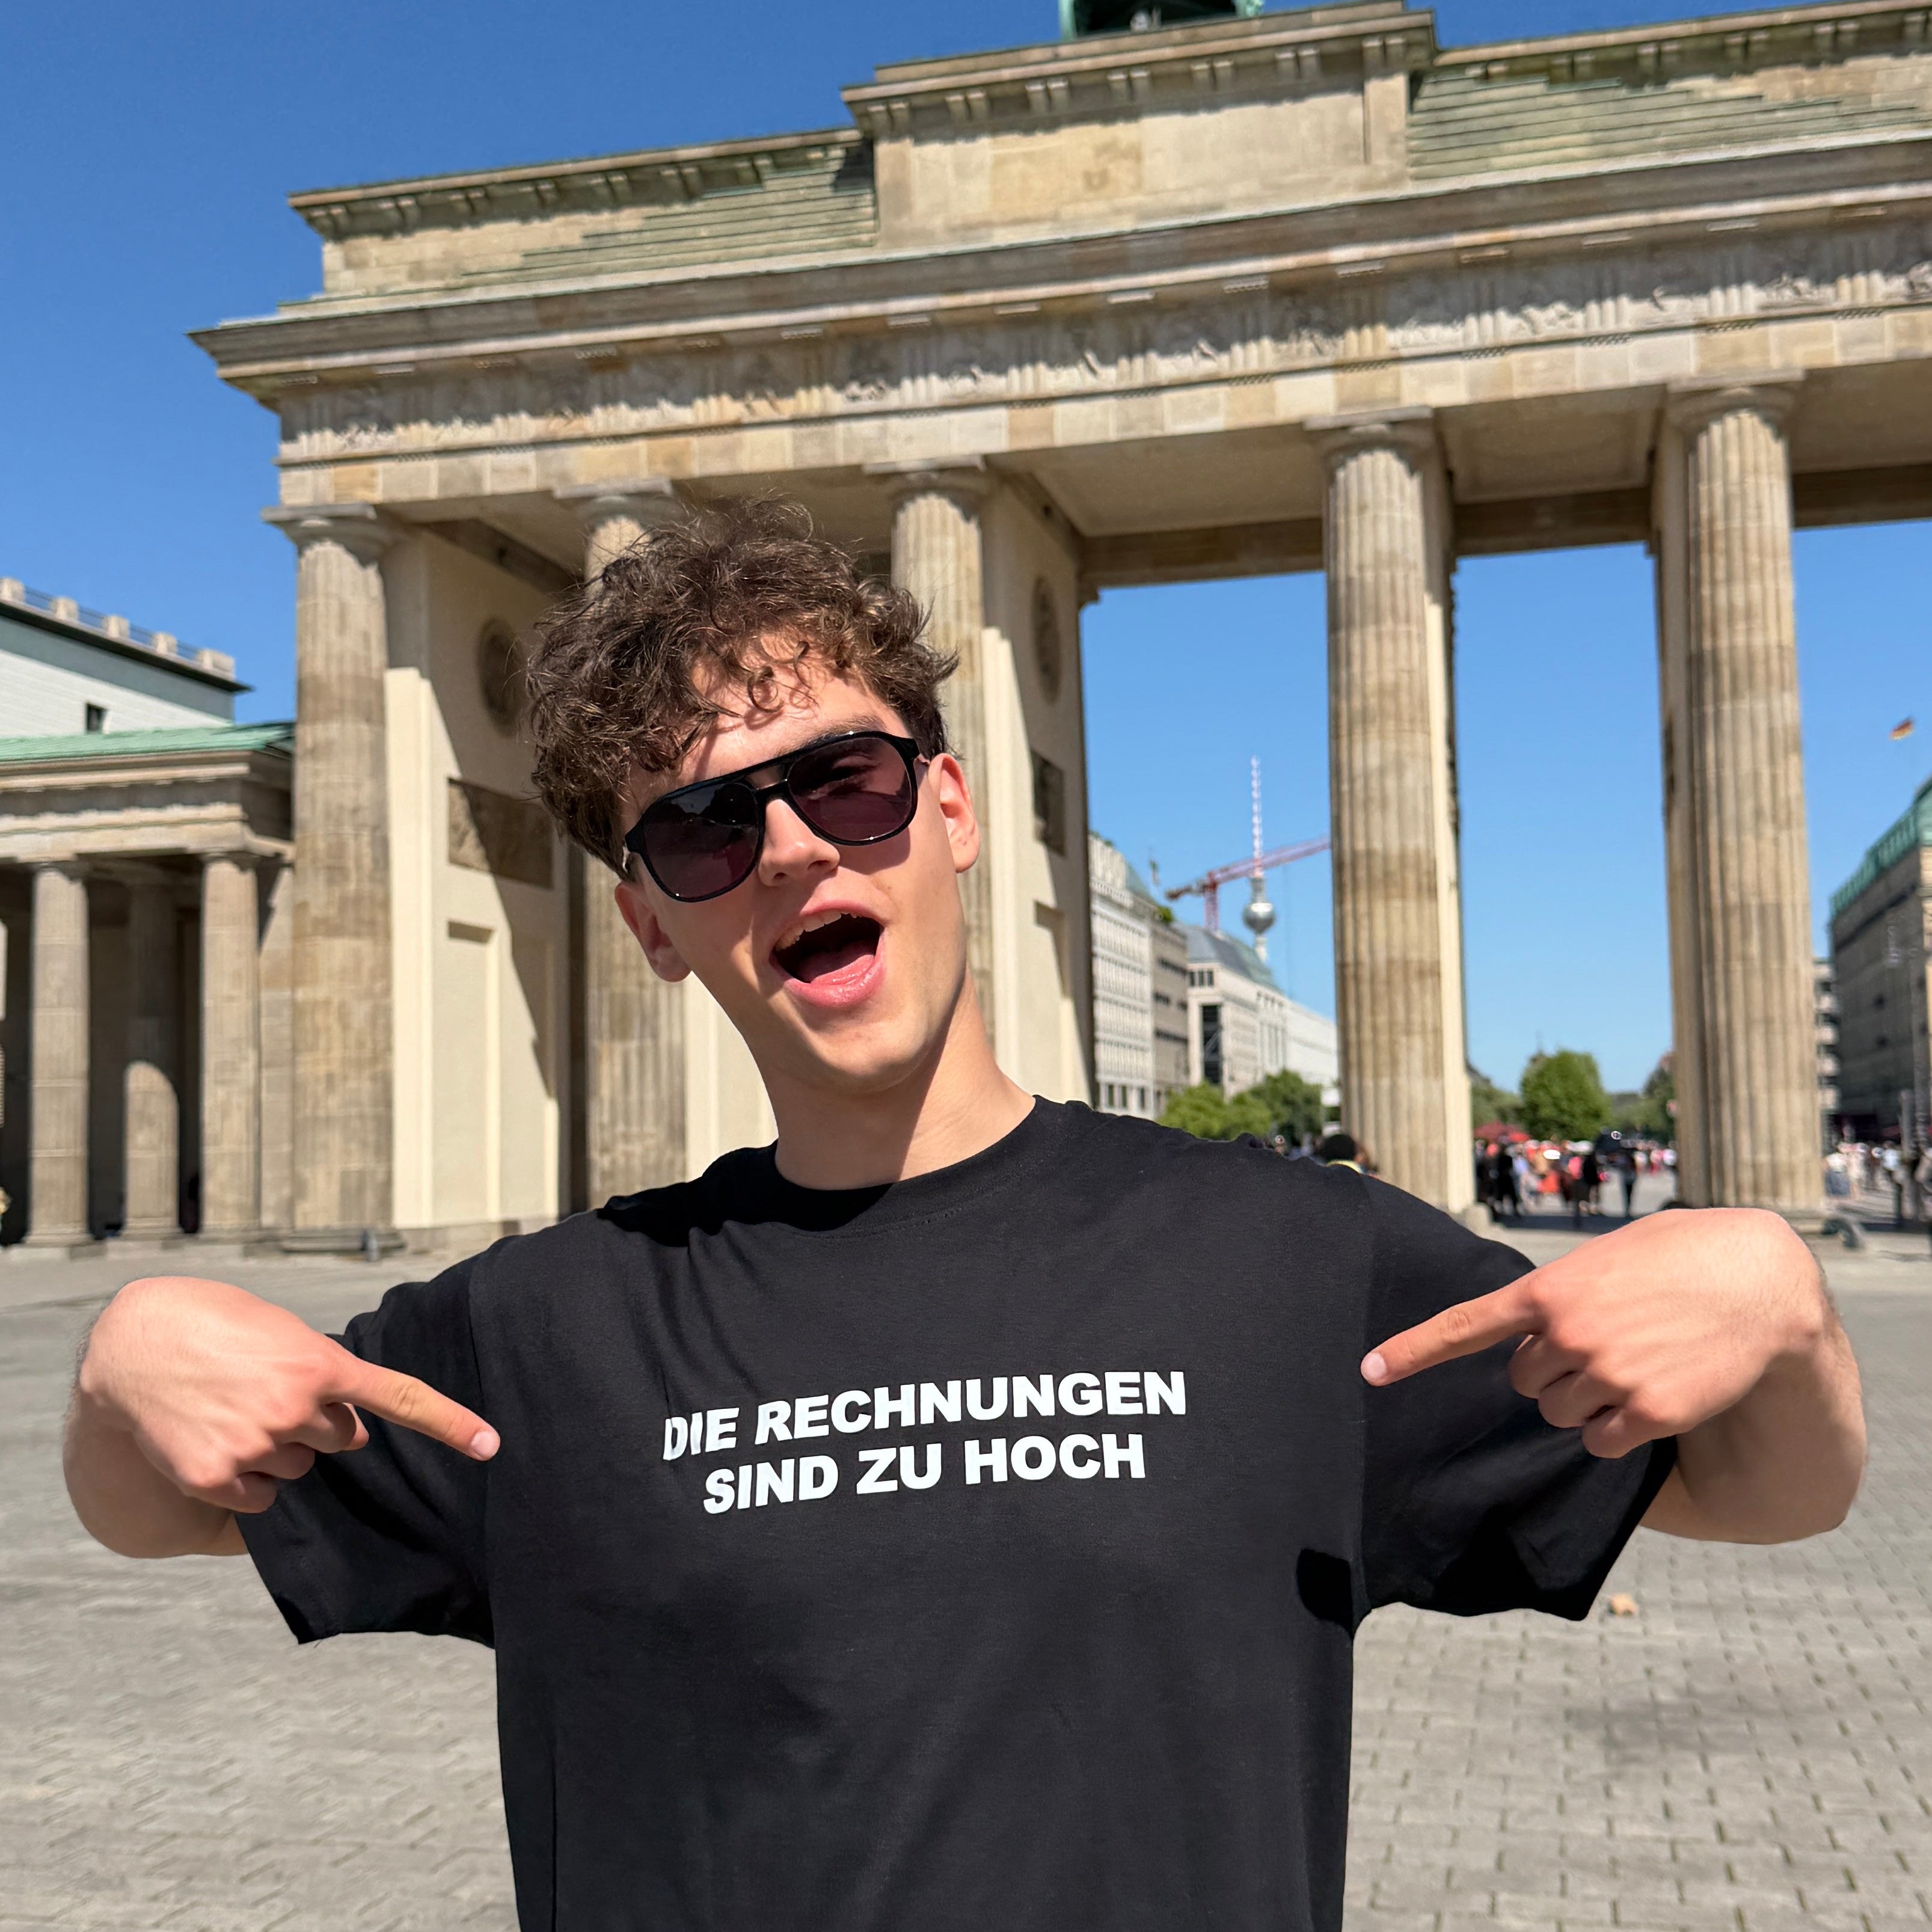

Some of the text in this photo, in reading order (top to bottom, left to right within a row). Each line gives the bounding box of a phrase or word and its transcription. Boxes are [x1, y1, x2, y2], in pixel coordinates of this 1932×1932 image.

[663, 1371, 1186, 1461] DIE RECHNUNGEN
[703, 1434, 1145, 1514] SIND ZU HOCH
